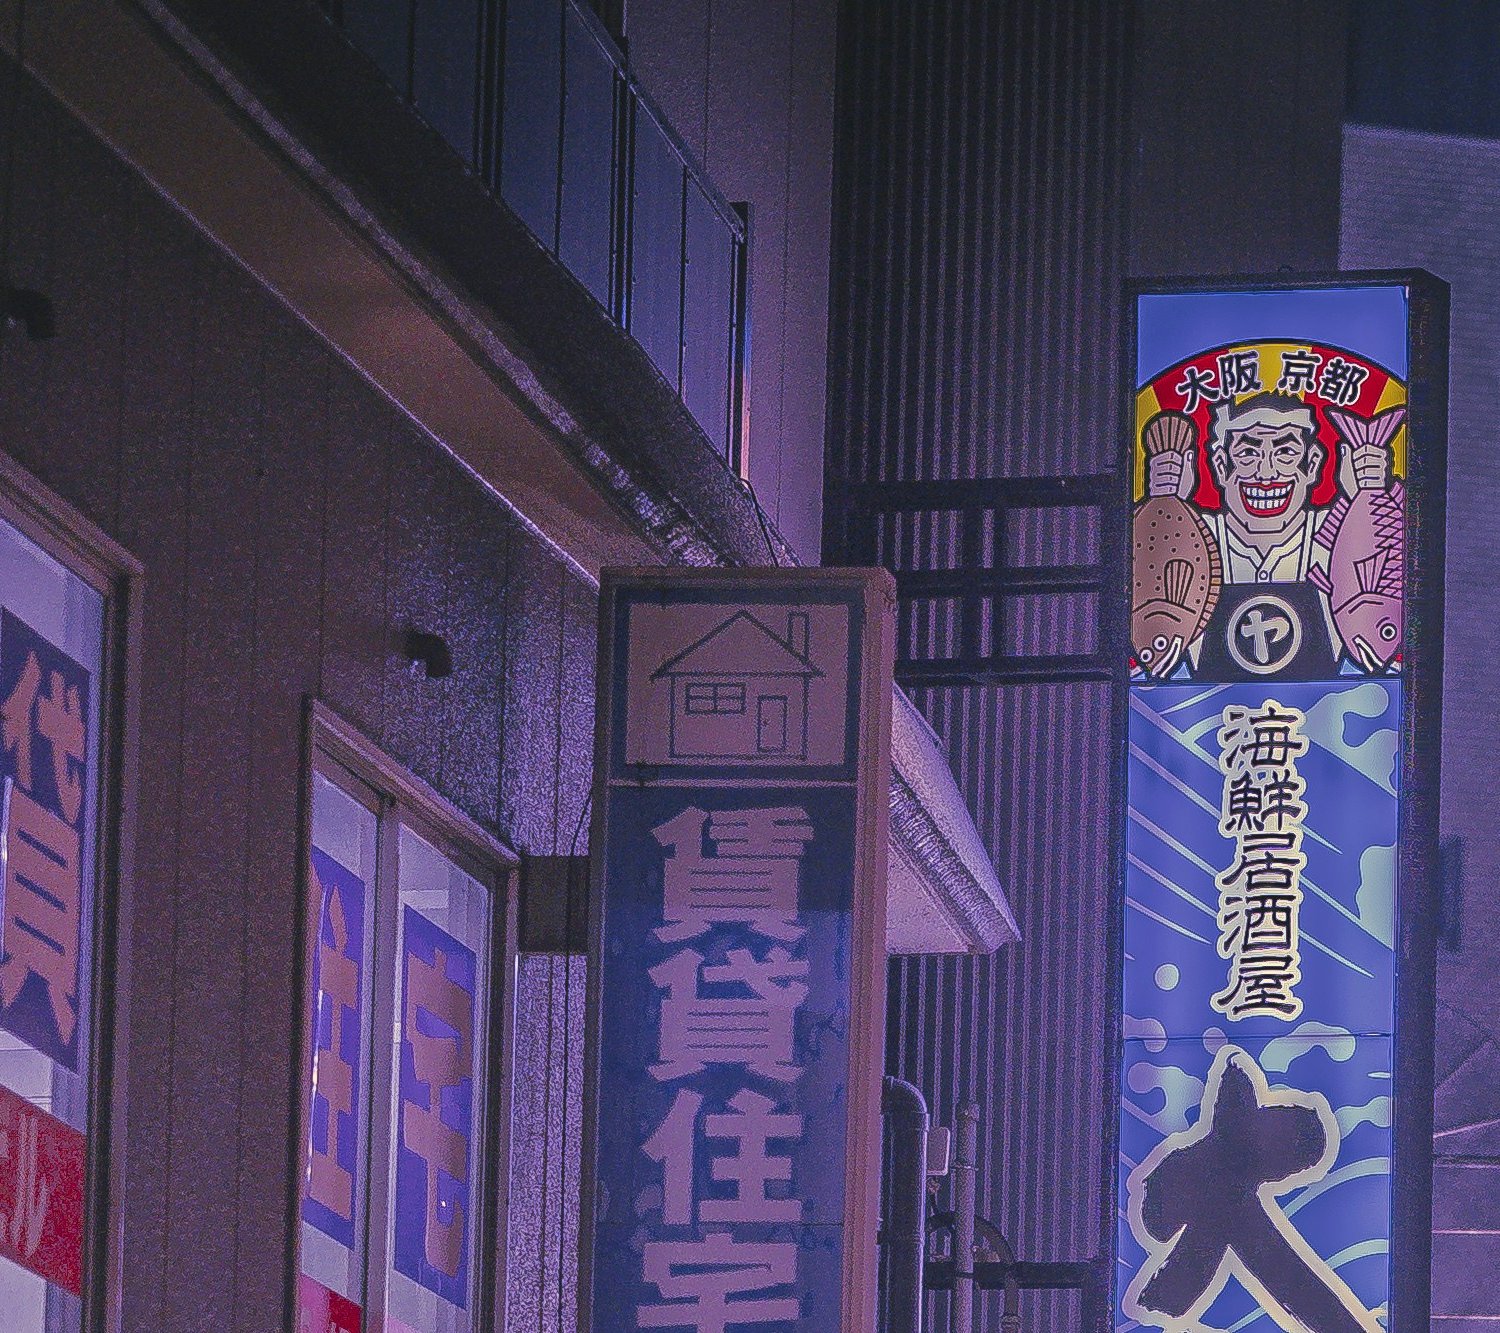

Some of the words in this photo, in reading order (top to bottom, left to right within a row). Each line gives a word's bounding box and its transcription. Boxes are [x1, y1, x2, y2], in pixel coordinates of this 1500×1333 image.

[1175, 350, 1262, 413] 大阪
[1278, 349, 1369, 409] 京都
[1218, 704, 1304, 1018] 海鮮居酒屋
